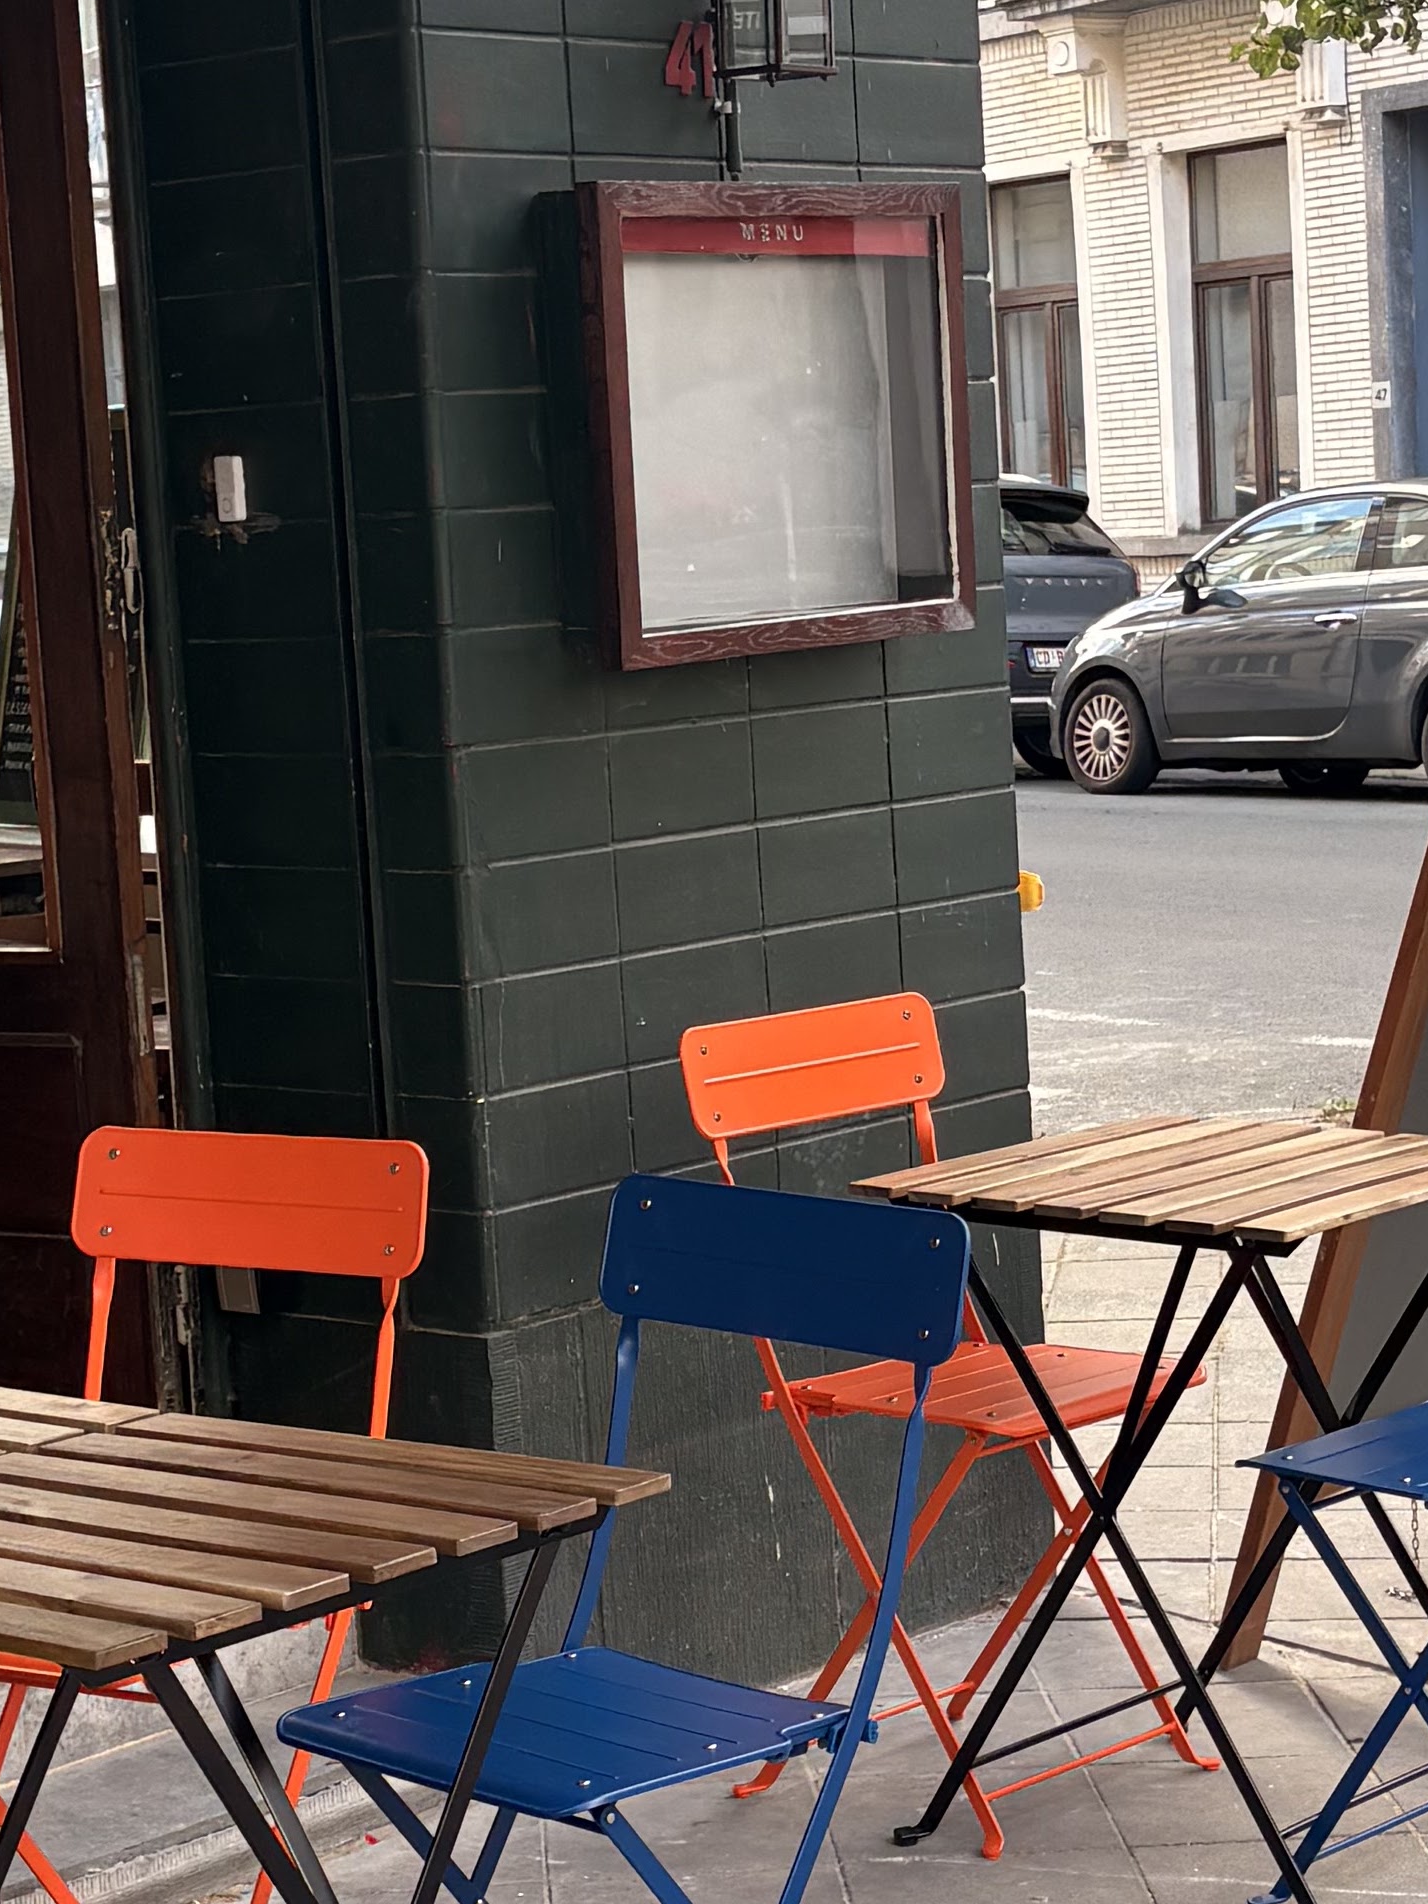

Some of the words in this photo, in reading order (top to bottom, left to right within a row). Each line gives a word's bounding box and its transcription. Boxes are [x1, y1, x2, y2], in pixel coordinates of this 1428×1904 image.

[665, 21, 715, 97] 41
[739, 222, 804, 242] MENU
[1375, 387, 1387, 400] 47
